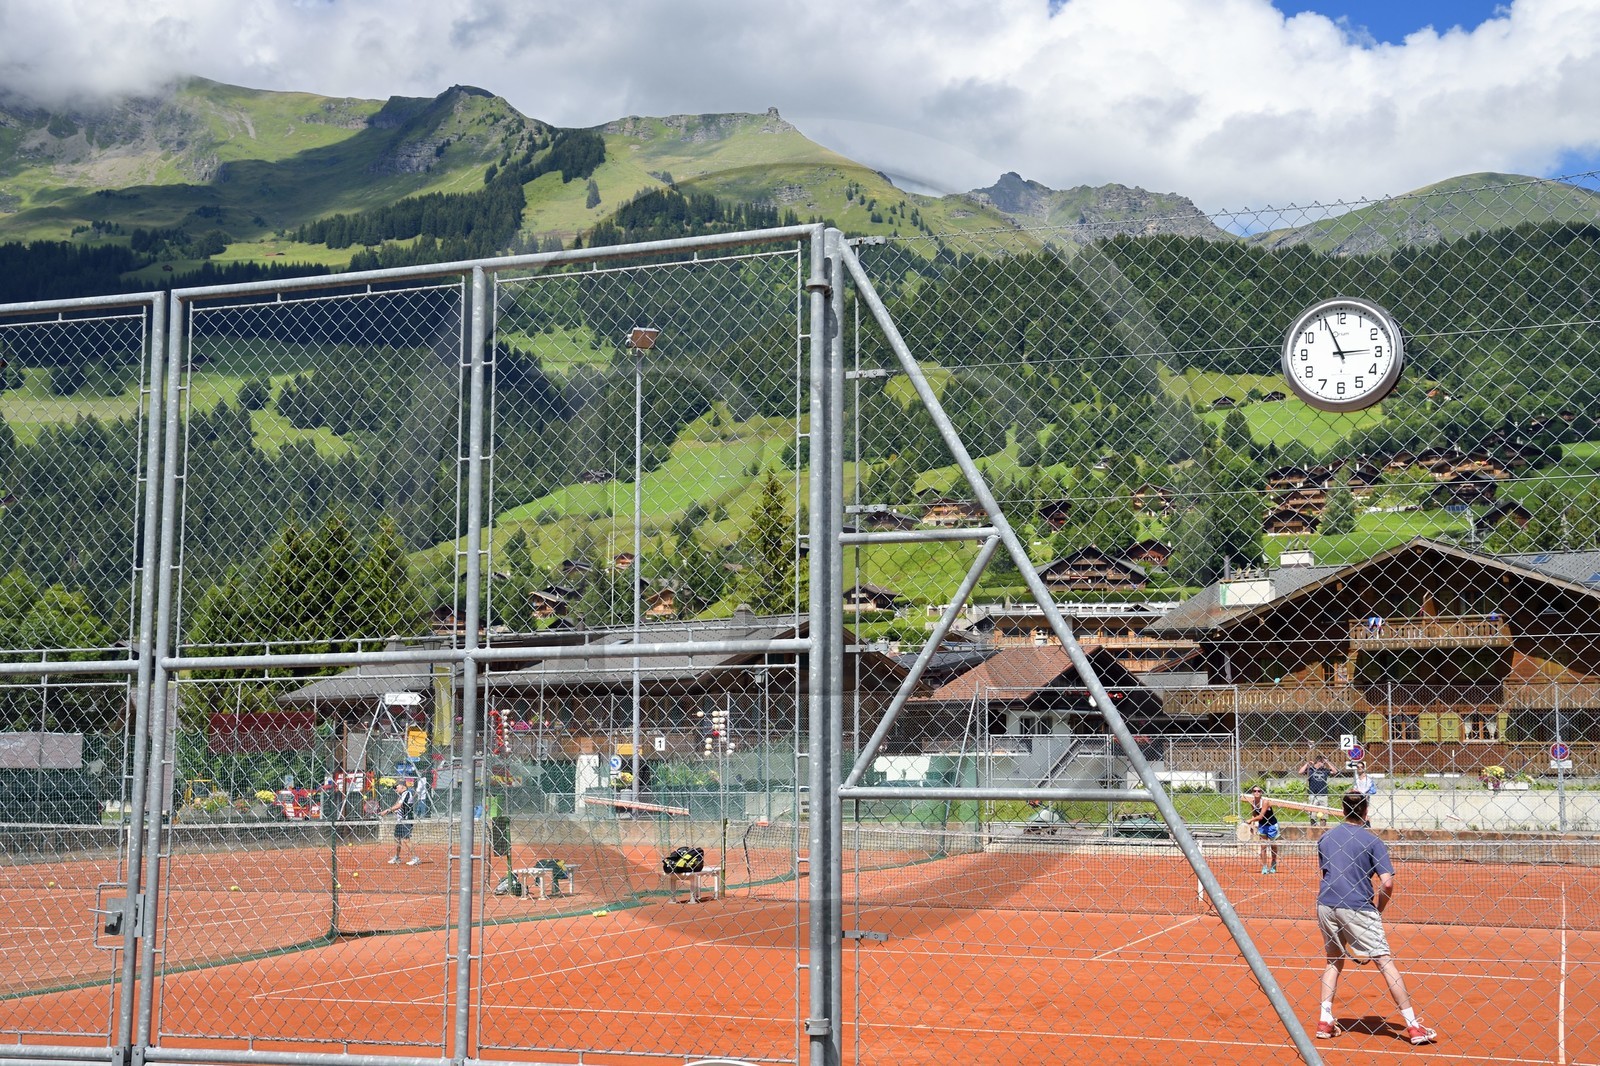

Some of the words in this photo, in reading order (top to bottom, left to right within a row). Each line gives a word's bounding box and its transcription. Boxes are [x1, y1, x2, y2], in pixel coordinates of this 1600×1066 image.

[1318, 318, 1327, 331] 11
[1336, 313, 1347, 325] 12
[1304, 332, 1315, 344] 10
[1370, 328, 1378, 341] 2
[1300, 349, 1308, 361] 9
[1374, 346, 1383, 358] 3
[1305, 366, 1314, 378] 8
[1368, 363, 1377, 375] 4
[1318, 379, 1328, 390] 7
[1336, 382, 1345, 394] 6
[1355, 376, 1364, 389] 5
[1343, 737, 1351, 747] 2
